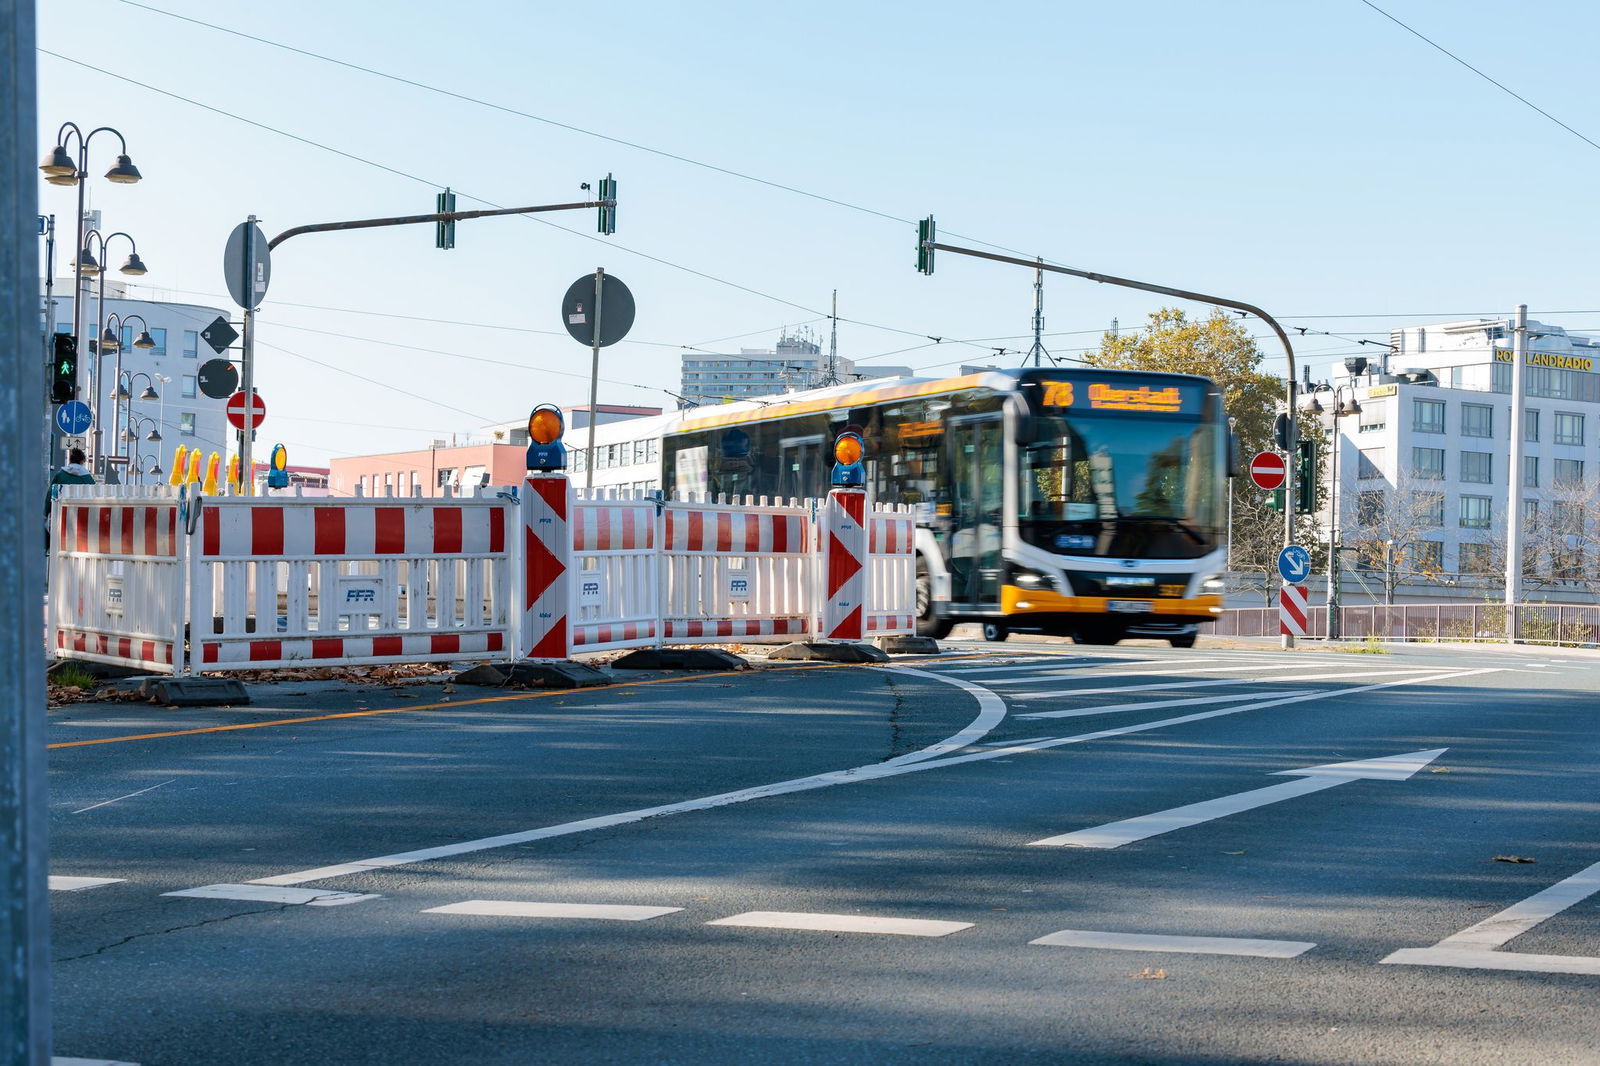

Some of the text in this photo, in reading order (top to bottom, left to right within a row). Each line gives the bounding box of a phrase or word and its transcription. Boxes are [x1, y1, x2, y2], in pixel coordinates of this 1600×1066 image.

[582, 582, 599, 596] FFR
[730, 580, 748, 592] FFR
[346, 589, 375, 602] FFR
